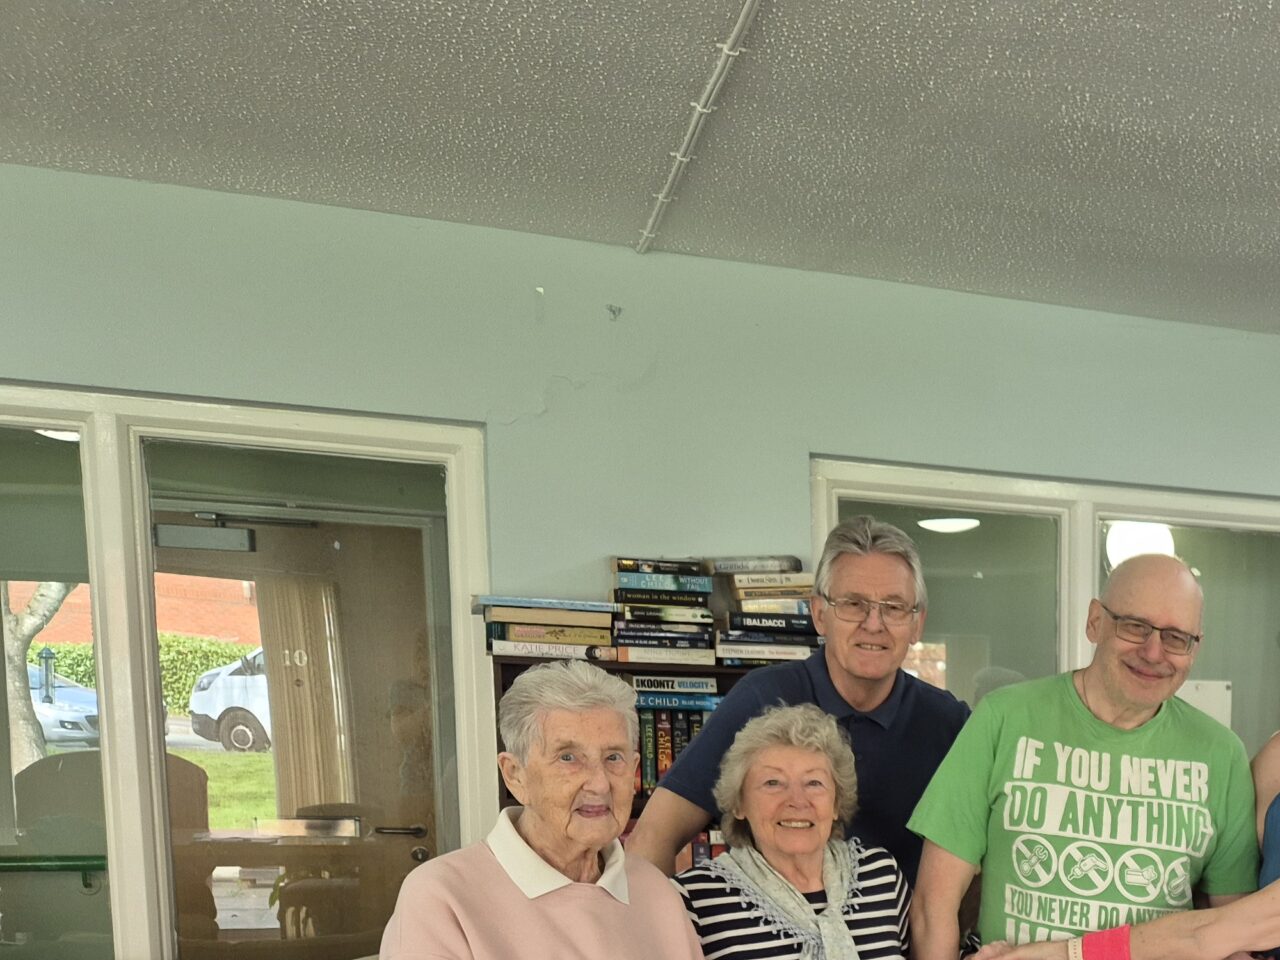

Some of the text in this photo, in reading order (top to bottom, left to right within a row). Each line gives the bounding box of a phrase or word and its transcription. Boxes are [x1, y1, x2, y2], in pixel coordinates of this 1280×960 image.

[679, 576, 708, 585] WITHOUT
[746, 618, 786, 628] BALDACCI
[284, 649, 308, 667] 10
[640, 678, 709, 689] KOONTZ VELOCITY
[648, 698, 680, 706] CHILD
[1013, 736, 1209, 802] IF YOU NEVER
[1008, 784, 1212, 853] DO ANYTHING
[1010, 888, 1033, 918] YOU
[1036, 894, 1091, 929] NEVER
[1097, 904, 1120, 929] DO
